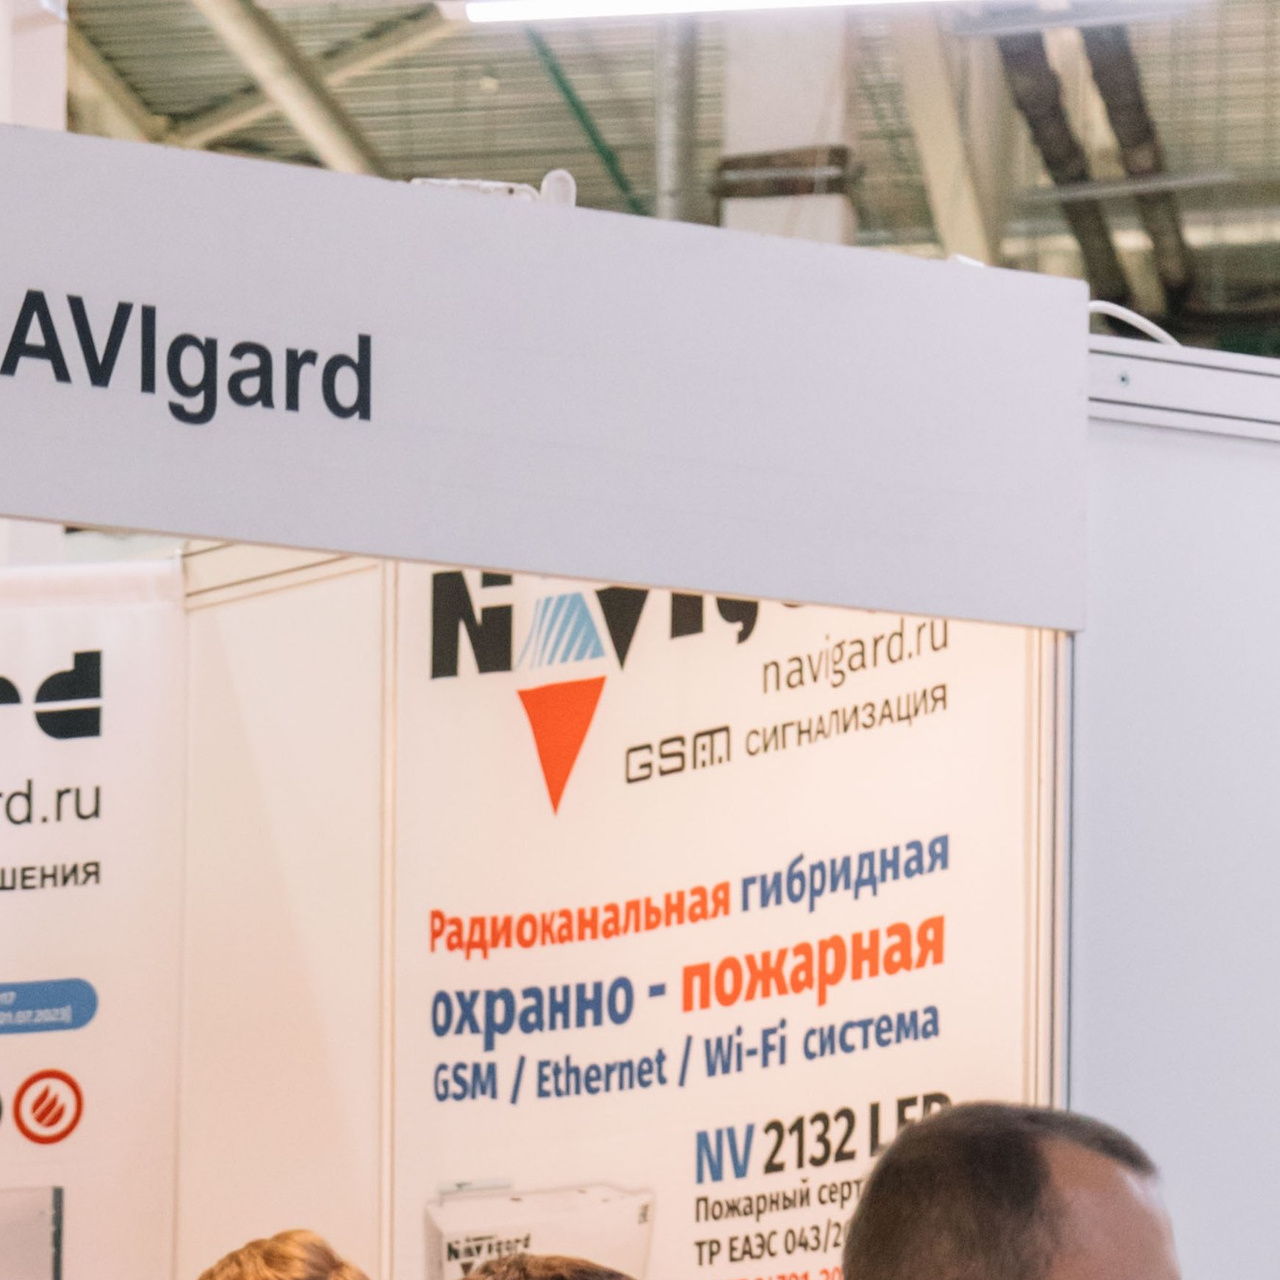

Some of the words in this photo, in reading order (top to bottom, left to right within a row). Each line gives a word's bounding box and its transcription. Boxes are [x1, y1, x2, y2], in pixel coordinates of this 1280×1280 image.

[762, 616, 949, 695] navigard.ru
[624, 725, 732, 785] GSM
[745, 683, 949, 757] СИГНАЛИЗАЦИЯ
[430, 880, 731, 960] Радиоканальная
[741, 833, 950, 913] гибридная
[430, 975, 635, 1052] охранно
[681, 914, 946, 1011] пожарная
[433, 1061, 498, 1103] GSM
[510, 1055, 526, 1105] /
[536, 1048, 668, 1099] Ethernet
[678, 1034, 693, 1087] /
[704, 1018, 788, 1078] Wi-Fi
[802, 1004, 940, 1061] система
[695, 1123, 755, 1185] NV
[763, 1107, 857, 1175] 2132
[695, 1178, 811, 1223] Пожарный
[695, 1239, 721, 1266] ТР
[728, 1230, 779, 1263] ЕАЭС
